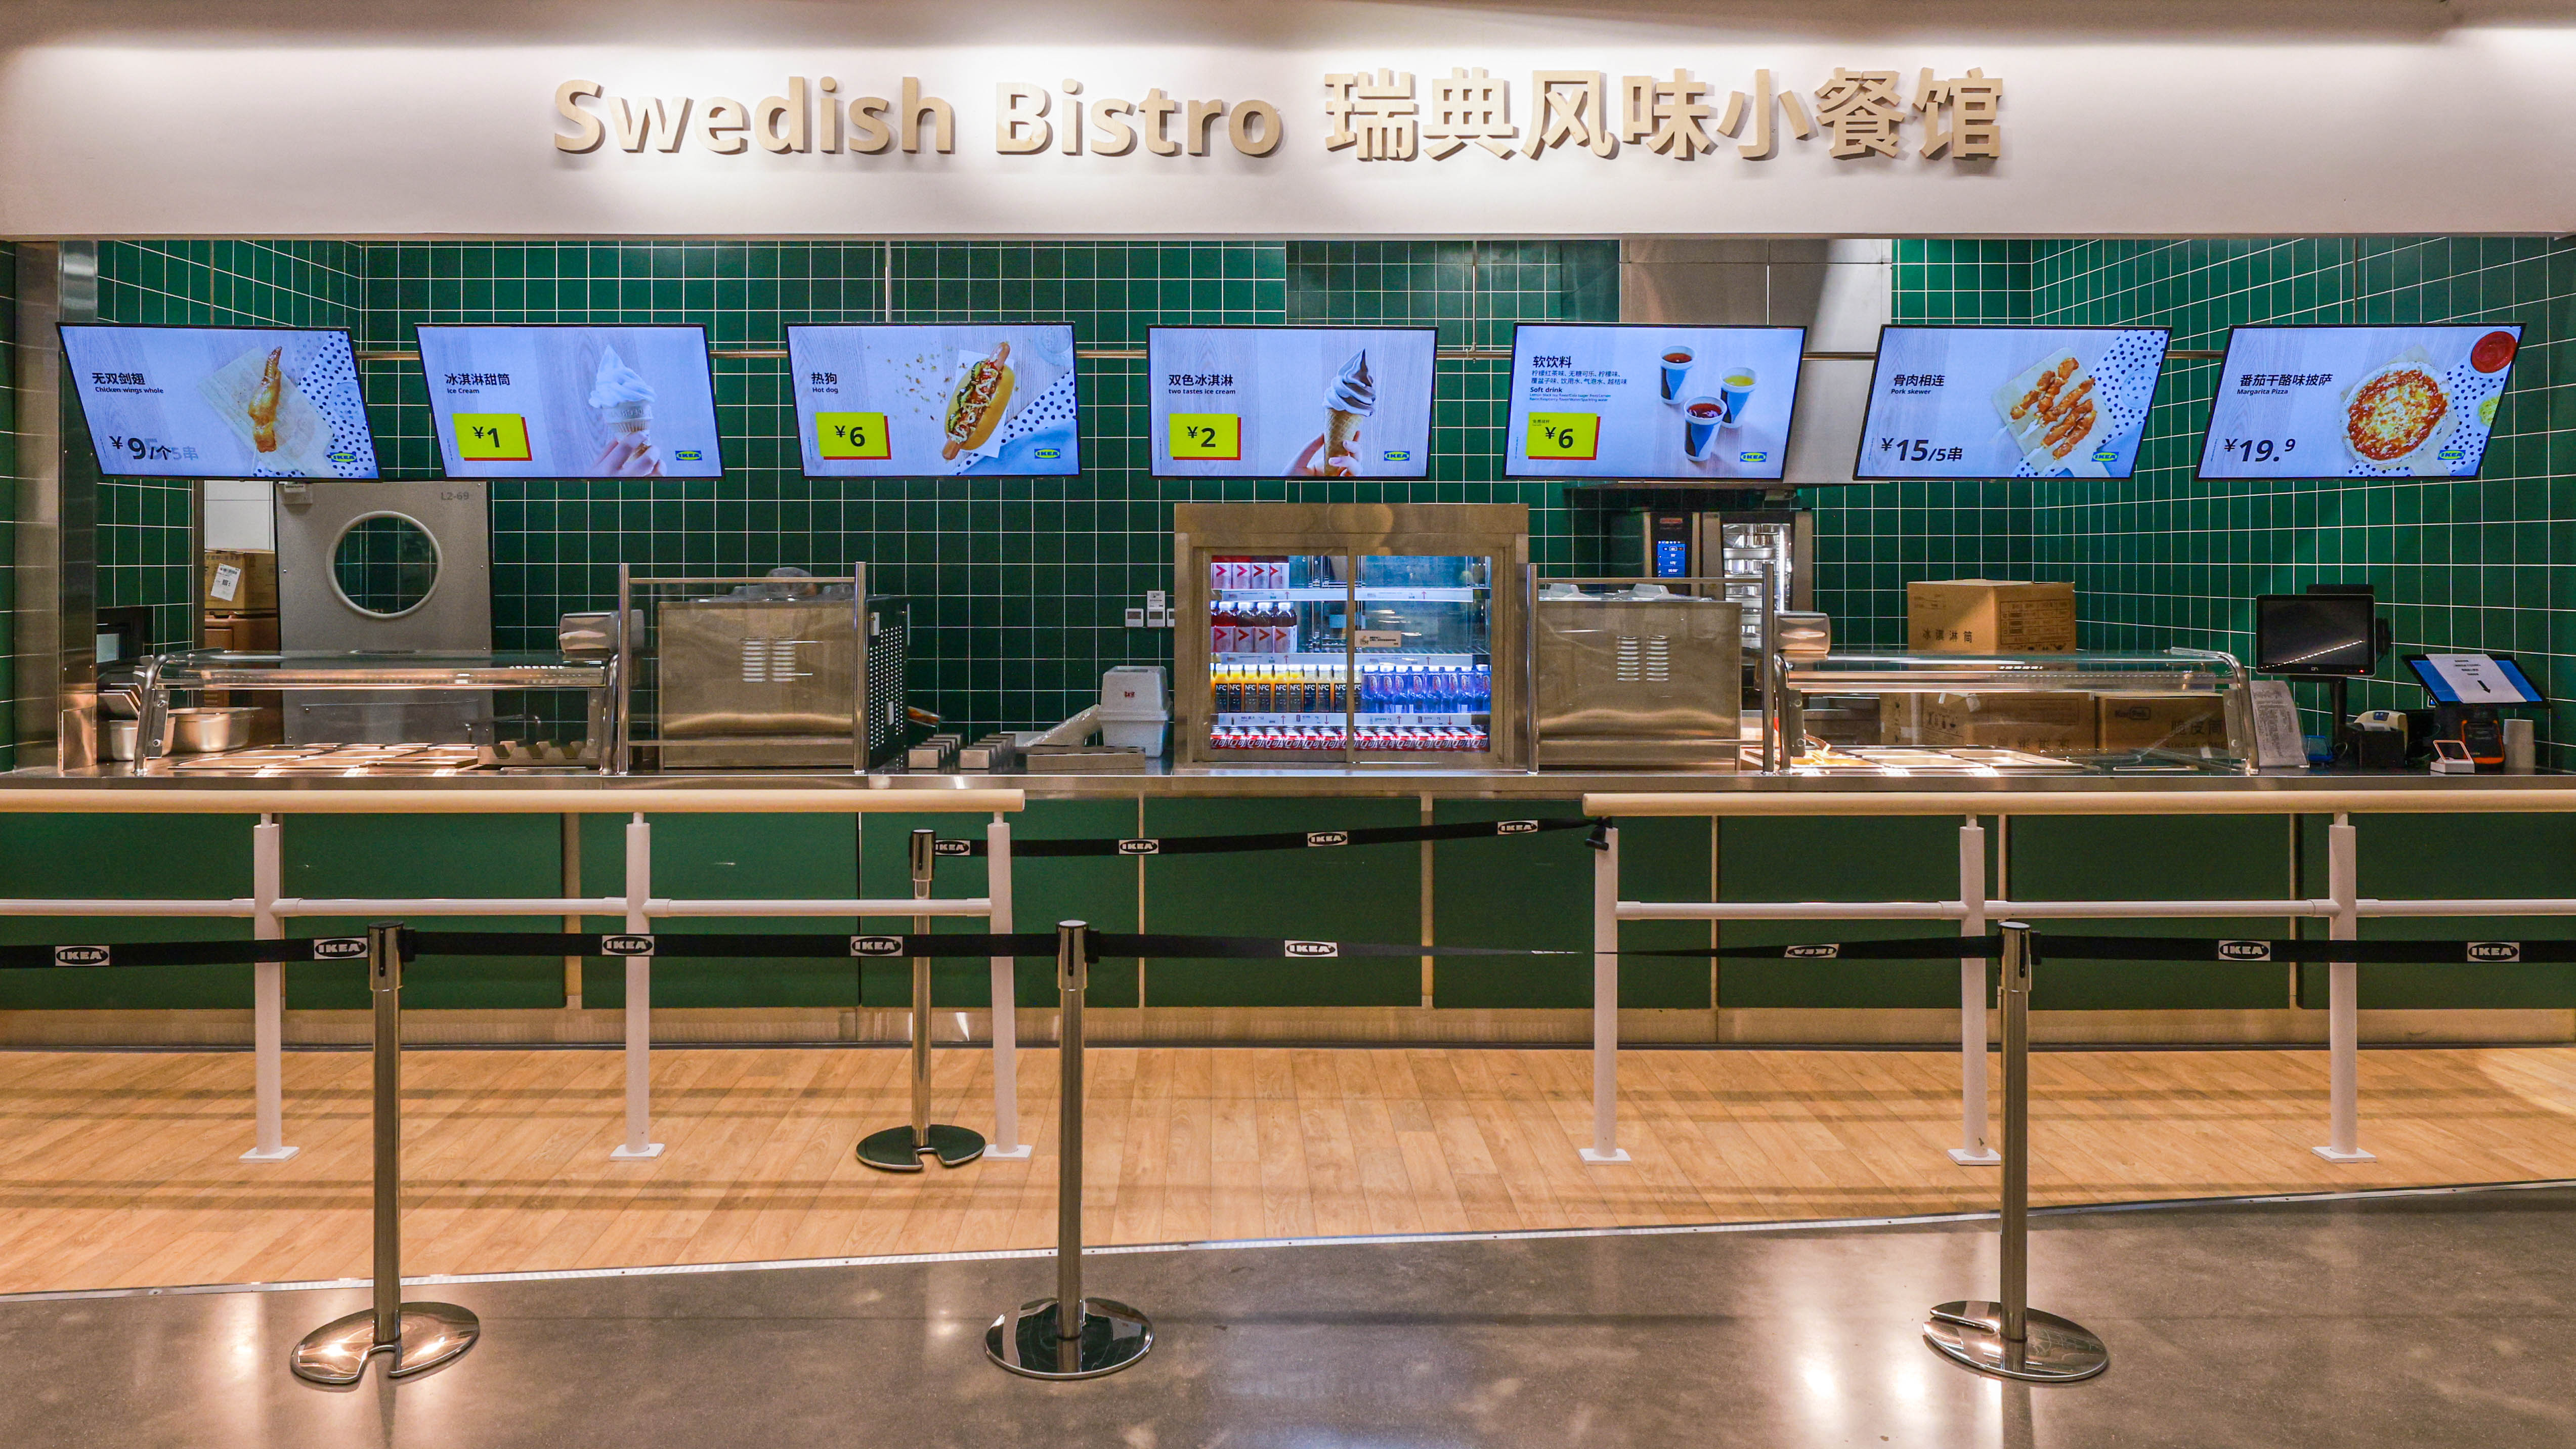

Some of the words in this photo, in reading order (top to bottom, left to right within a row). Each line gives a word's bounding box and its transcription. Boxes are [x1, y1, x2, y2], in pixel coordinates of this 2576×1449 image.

[553, 76, 956, 154] Swedish
[995, 77, 1282, 158] Bistro
[1324, 66, 2003, 161] 瑞典风味小餐馆
[1532, 355, 1572, 368] 软饮料
[92, 372, 146, 385] 无双剑翅
[444, 372, 510, 387] 冰淇淋甜筒
[811, 372, 837, 386] 热狗
[1168, 374, 1233, 387] 双色冰淇淋
[1894, 374, 1945, 387] 骨肉相连
[2240, 373, 2333, 387] 番茄干酪味披萨
[826, 387, 838, 395] dog
[2237, 388, 2270, 396] Margarita
[1922, 628, 1972, 644] 冰淇淋筒
[318, 943, 360, 953] IKEA
[607, 941, 647, 950] IKEA
[855, 941, 895, 950] IKEA
[2223, 946, 2263, 955] IKEA
[2471, 947, 2512, 956] IKEA
[60, 951, 102, 960] IKEA
